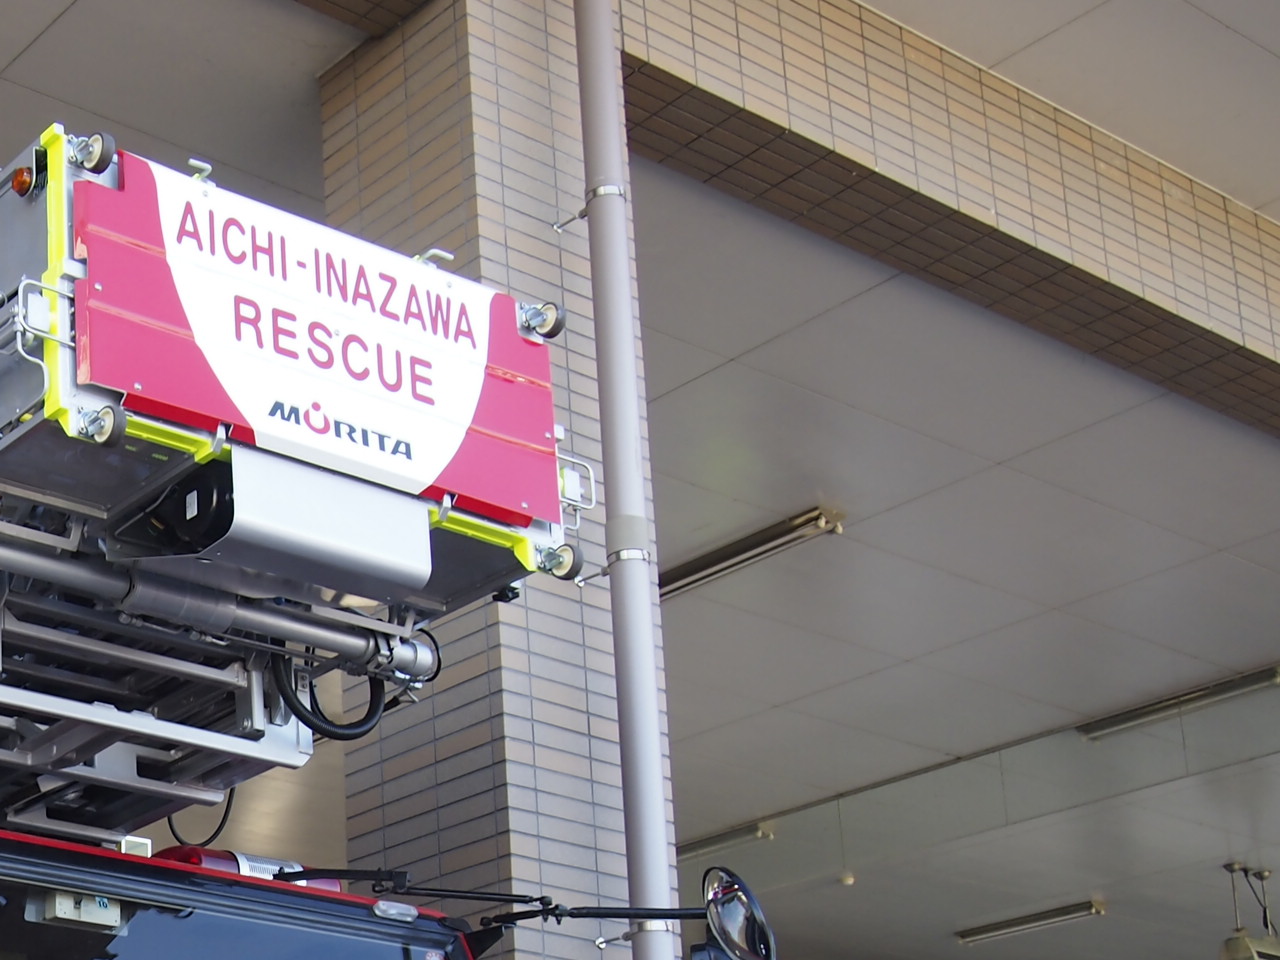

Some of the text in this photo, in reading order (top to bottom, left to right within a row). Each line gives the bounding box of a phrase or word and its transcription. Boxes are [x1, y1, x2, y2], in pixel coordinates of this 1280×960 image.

[175, 200, 477, 350] AICHI-INAZAWA
[232, 294, 437, 407] RESCUE
[267, 400, 413, 461] MORITA
